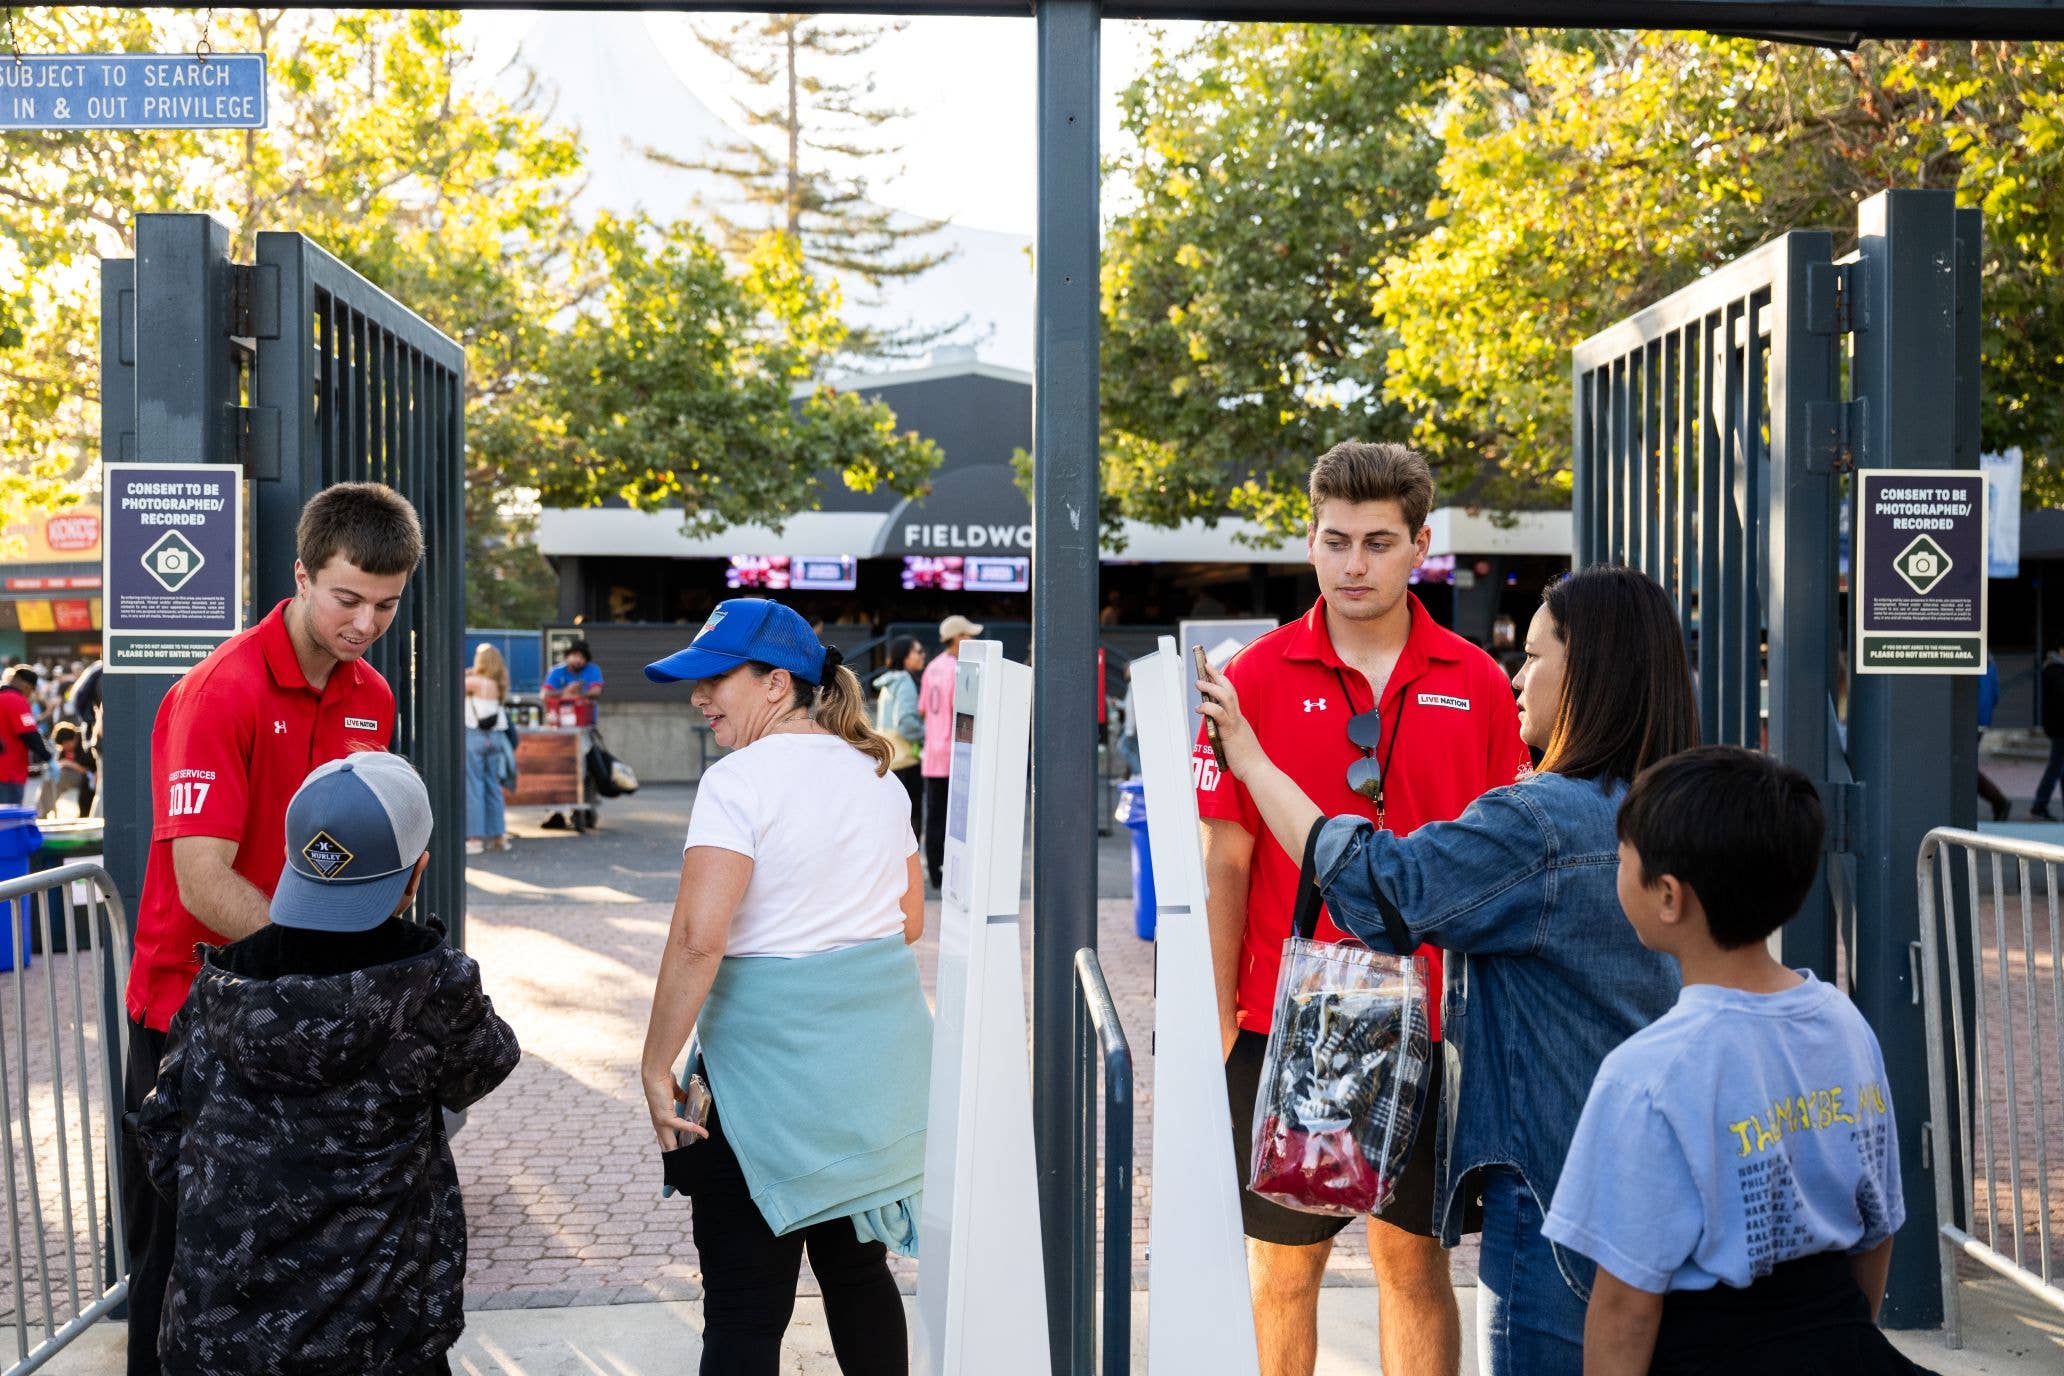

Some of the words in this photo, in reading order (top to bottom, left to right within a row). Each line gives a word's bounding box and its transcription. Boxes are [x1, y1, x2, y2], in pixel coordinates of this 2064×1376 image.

[102, 65, 126, 87] TO
[144, 65, 230, 87] SEARCH
[14, 98, 35, 119] IN
[53, 97, 71, 119] &
[87, 97, 128, 119] OUT
[144, 97, 254, 119] PRIVILEGE
[127, 483, 183, 495] CONSENT
[185, 484, 201, 496] TO
[203, 484, 220, 496] BE
[1880, 489, 1935, 501] CONSENT
[1935, 489, 1950, 501] TO
[1952, 489, 1967, 502] BE
[121, 498, 225, 511] PHOTOGRAPHED/
[1875, 503, 1972, 516] PHOTOGRAPHED/
[141, 513, 205, 525] RECORDED
[1893, 518, 1954, 530] RECORDED
[154, 650, 168, 658] NOT
[169, 650, 190, 658] ENTER
[1918, 651, 1939, 659] ENTER
[1939, 651, 1955, 659] THIS
[1440, 697, 1467, 708] NATION
[346, 719, 359, 727] LIVE
[180, 769, 216, 780] SERVICES
[168, 782, 211, 817] 1017
[311, 852, 341, 861] HURLEY
